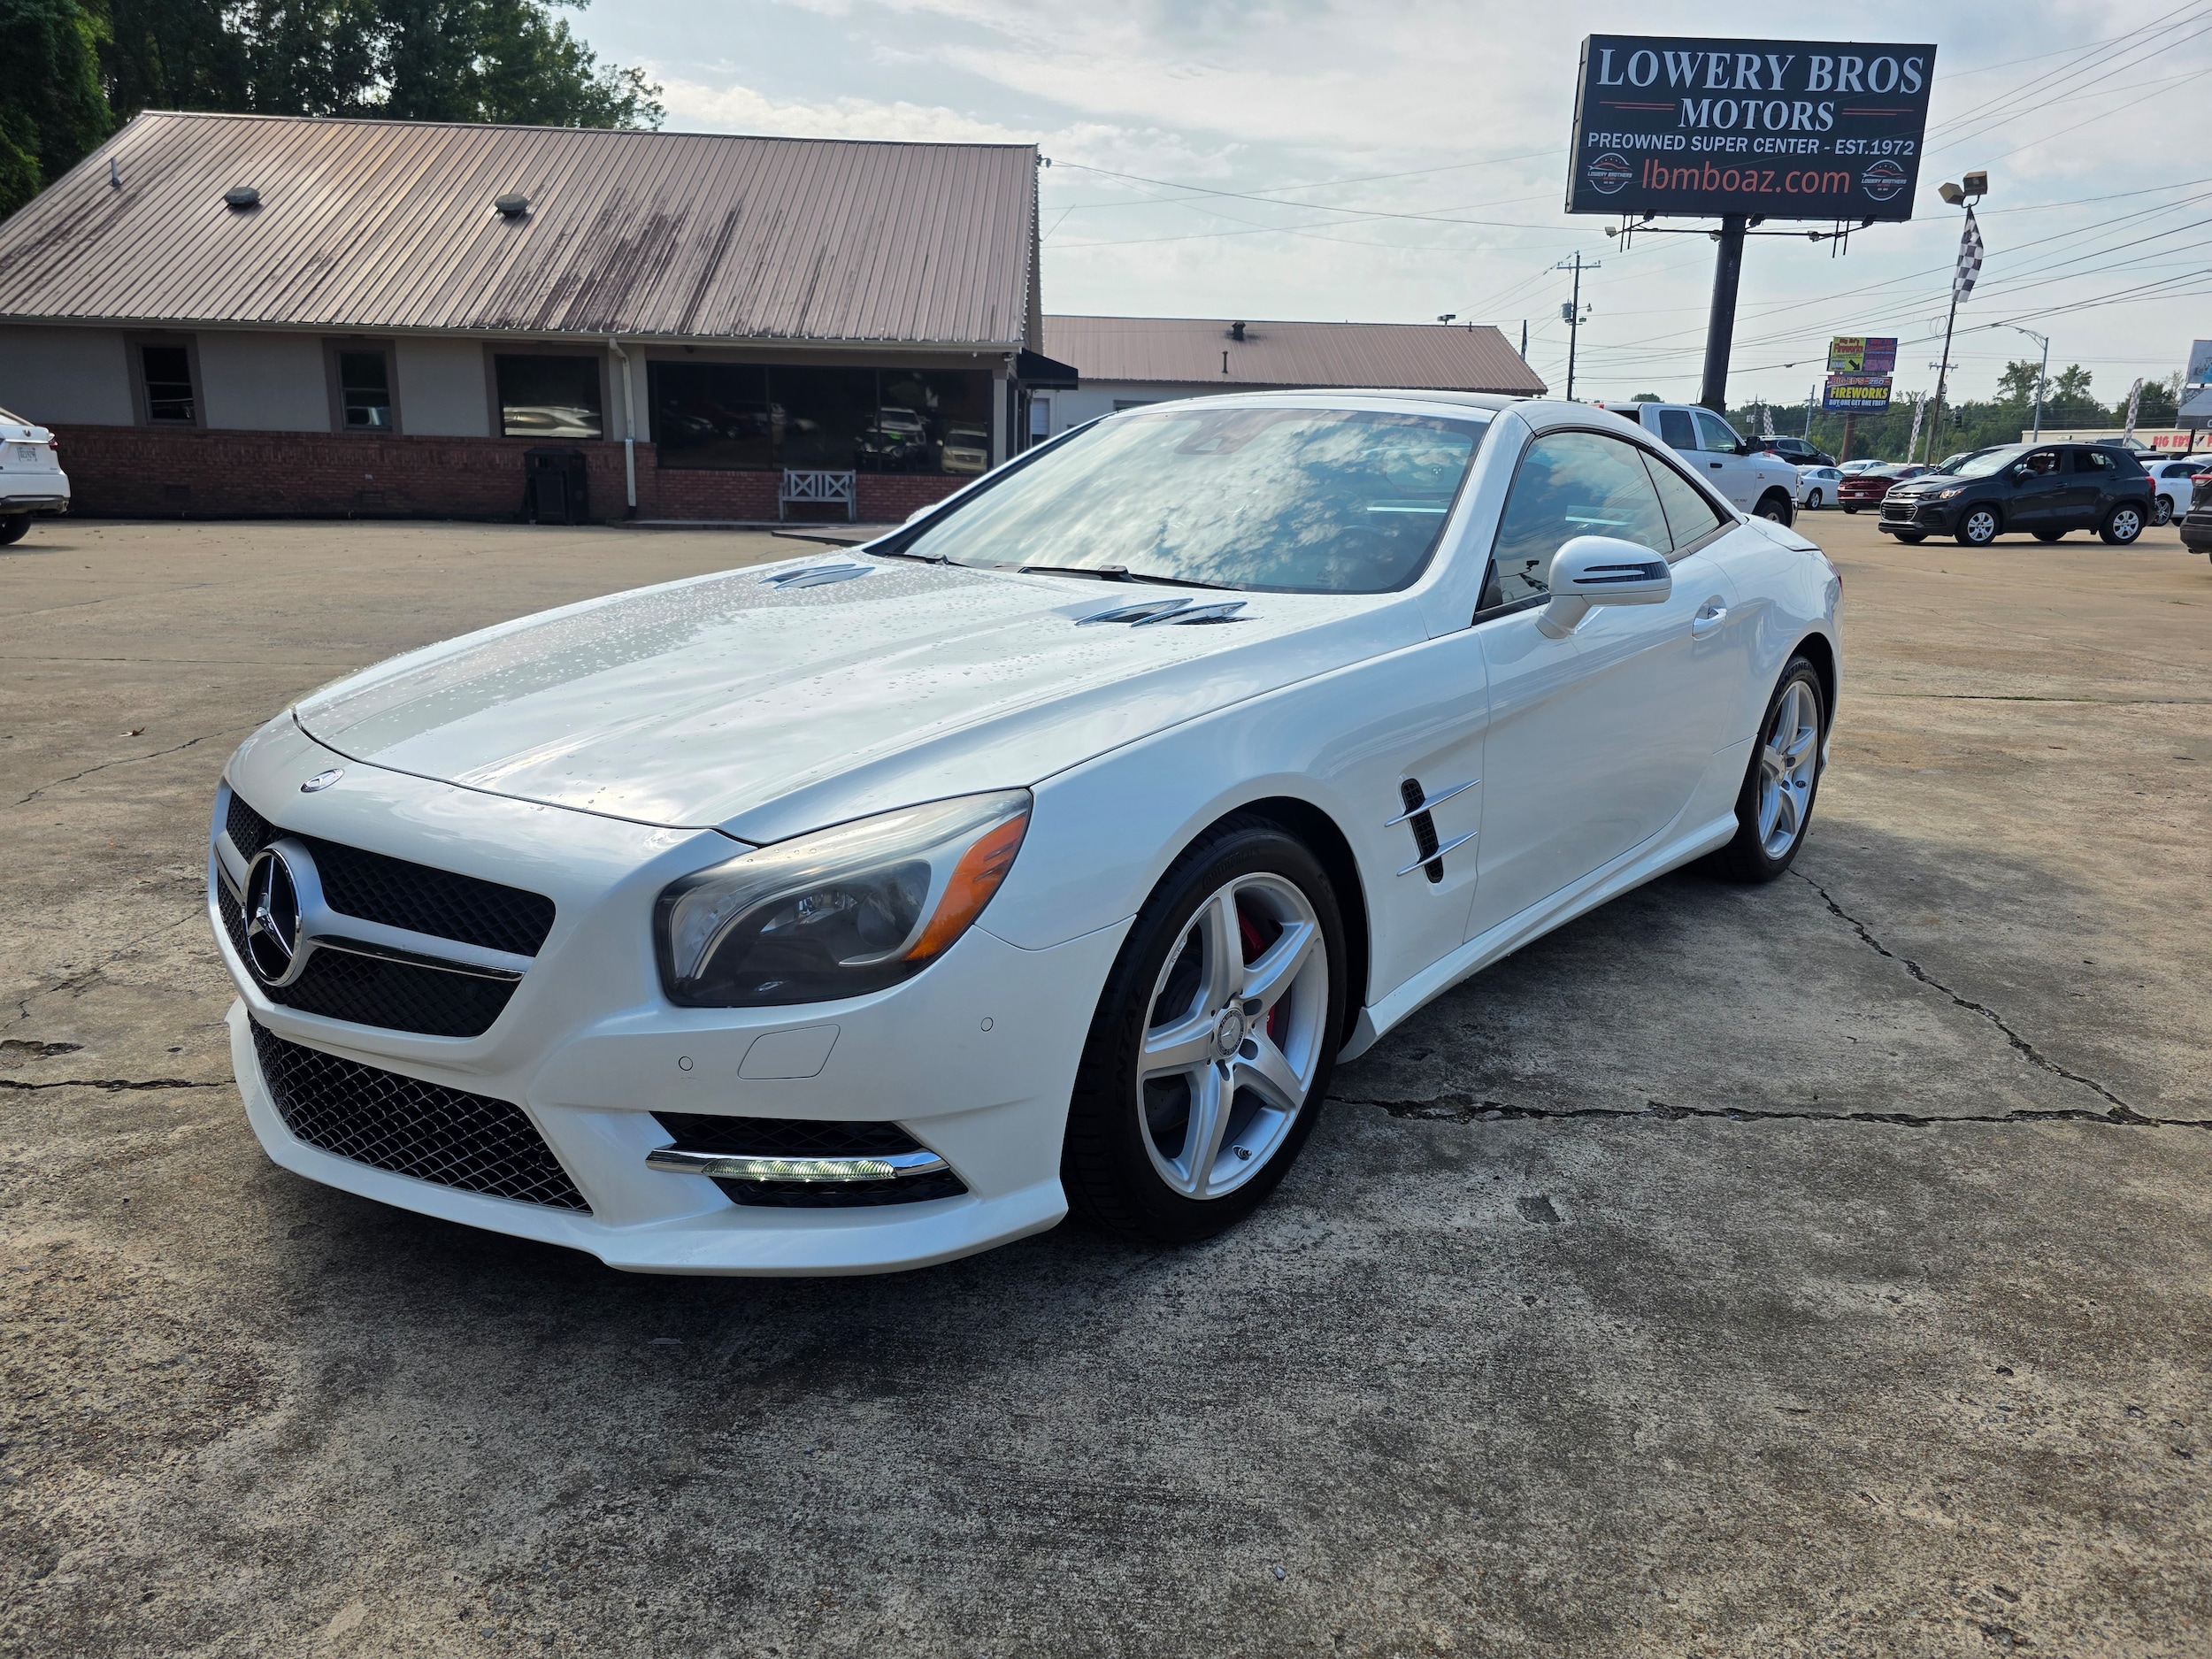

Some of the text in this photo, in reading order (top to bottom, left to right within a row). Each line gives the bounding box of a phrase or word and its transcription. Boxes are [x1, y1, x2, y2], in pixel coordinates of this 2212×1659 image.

[1596, 48, 1924, 95] LOWERY BROS
[1678, 97, 1835, 132] MOTORS
[1587, 132, 1686, 151] PREOWNED
[1690, 135, 1747, 152] SUPER
[1753, 137, 1820, 154] CENTER
[1834, 139, 1915, 156] EST.1972
[1641, 158, 1851, 194] lbmboaz.com
[1830, 387, 1888, 399] FIREWORKS
[2153, 435, 2170, 448] BIG
